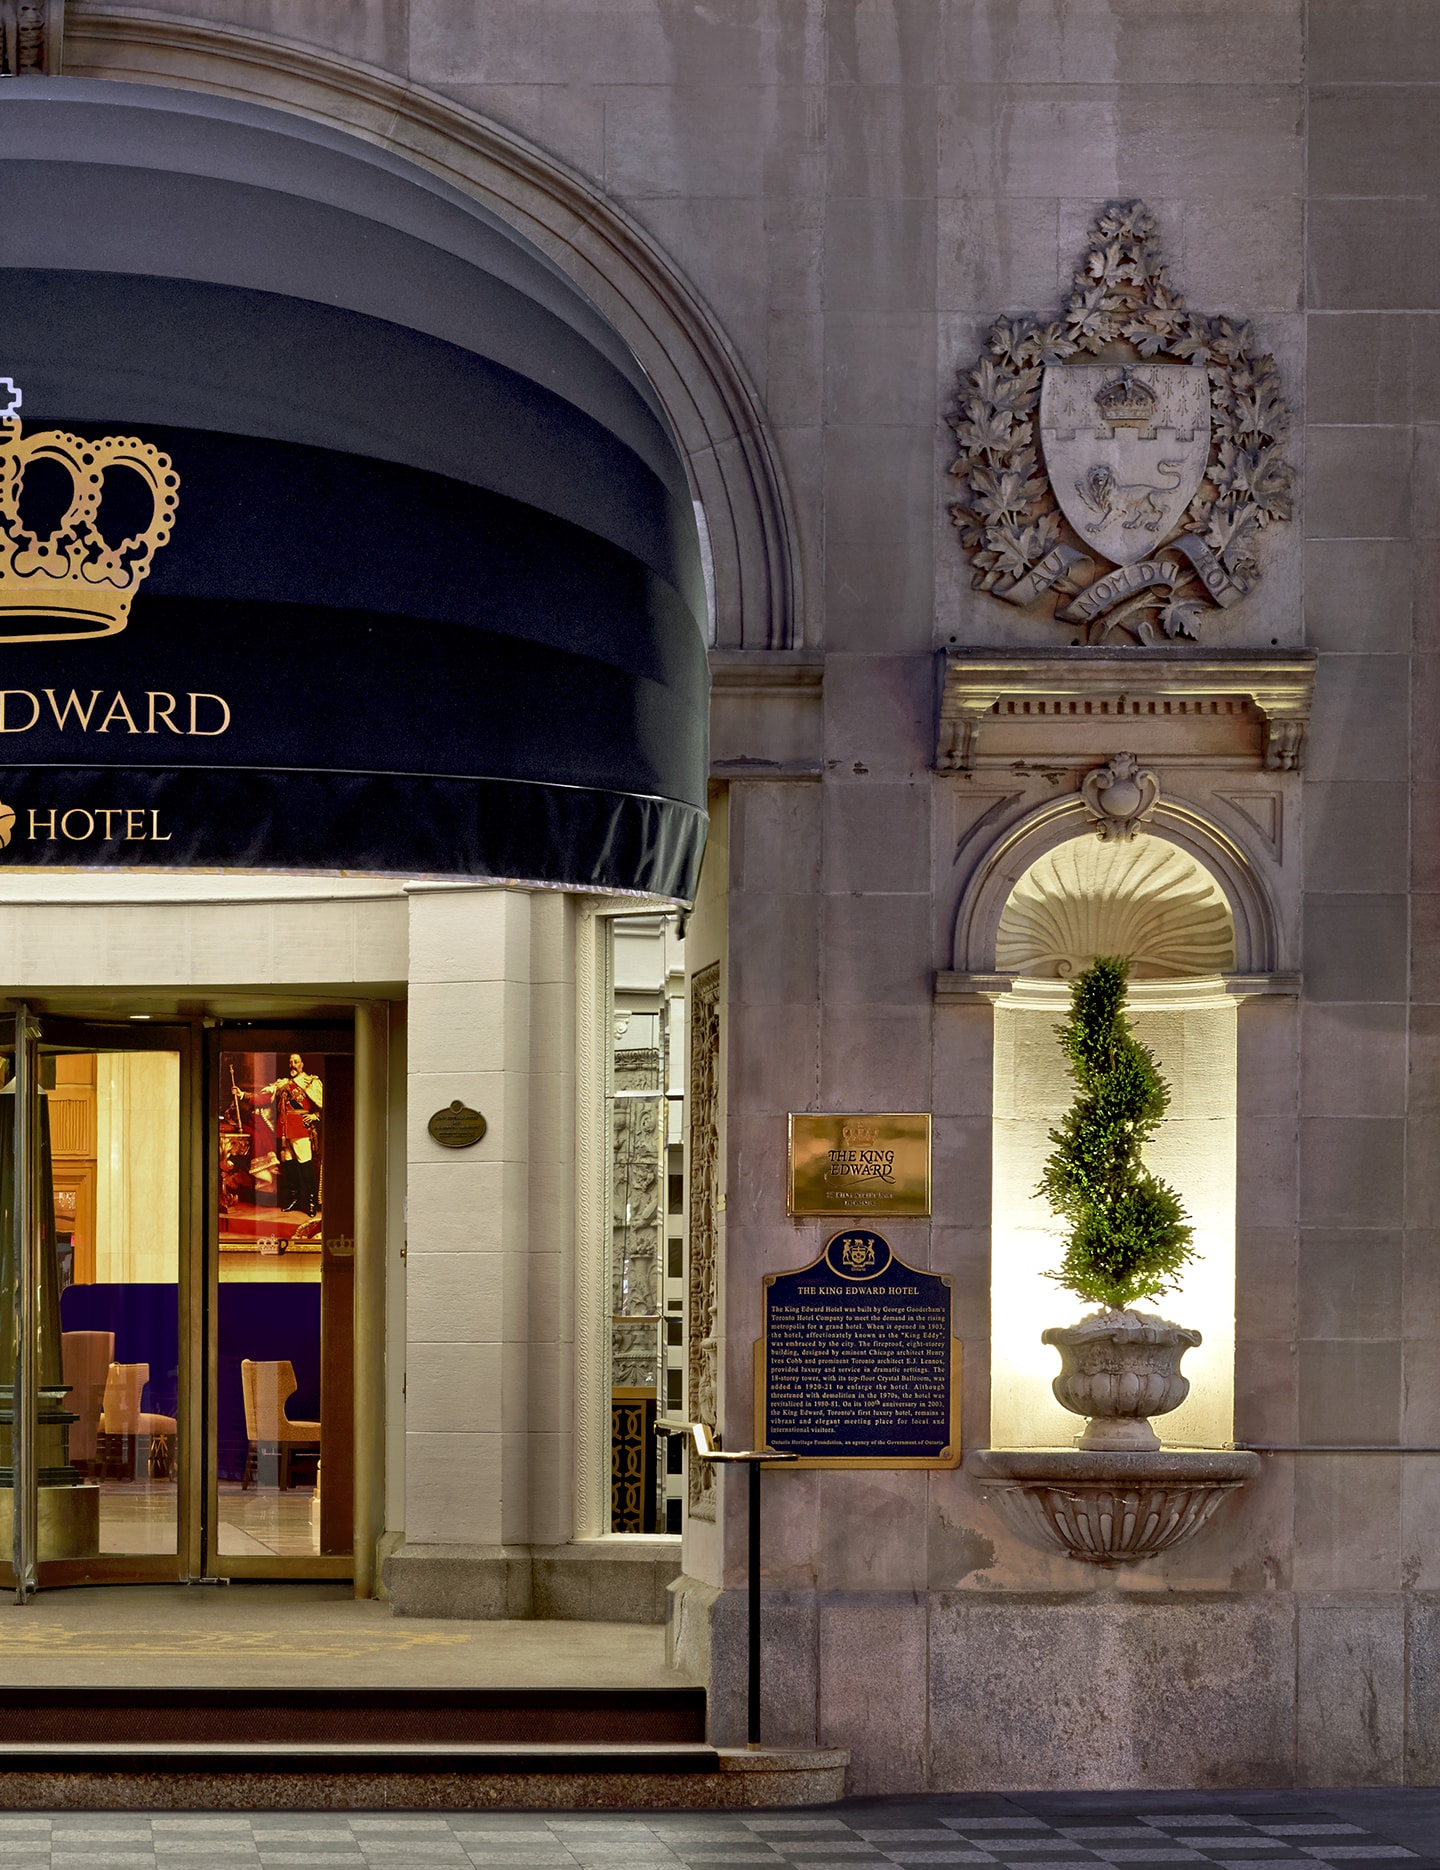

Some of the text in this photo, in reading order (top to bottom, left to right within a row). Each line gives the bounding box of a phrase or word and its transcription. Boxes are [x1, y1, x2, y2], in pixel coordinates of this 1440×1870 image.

[1028, 552, 1062, 592] AU
[1077, 571, 1132, 615] NOM
[1139, 563, 1178, 584] DU
[27, 808, 172, 841] HOTEL
[828, 1150, 894, 1165] THE KING
[829, 1163, 893, 1178] EDWARD
[797, 1287, 920, 1295] THE KING EDWARD HOTEL
